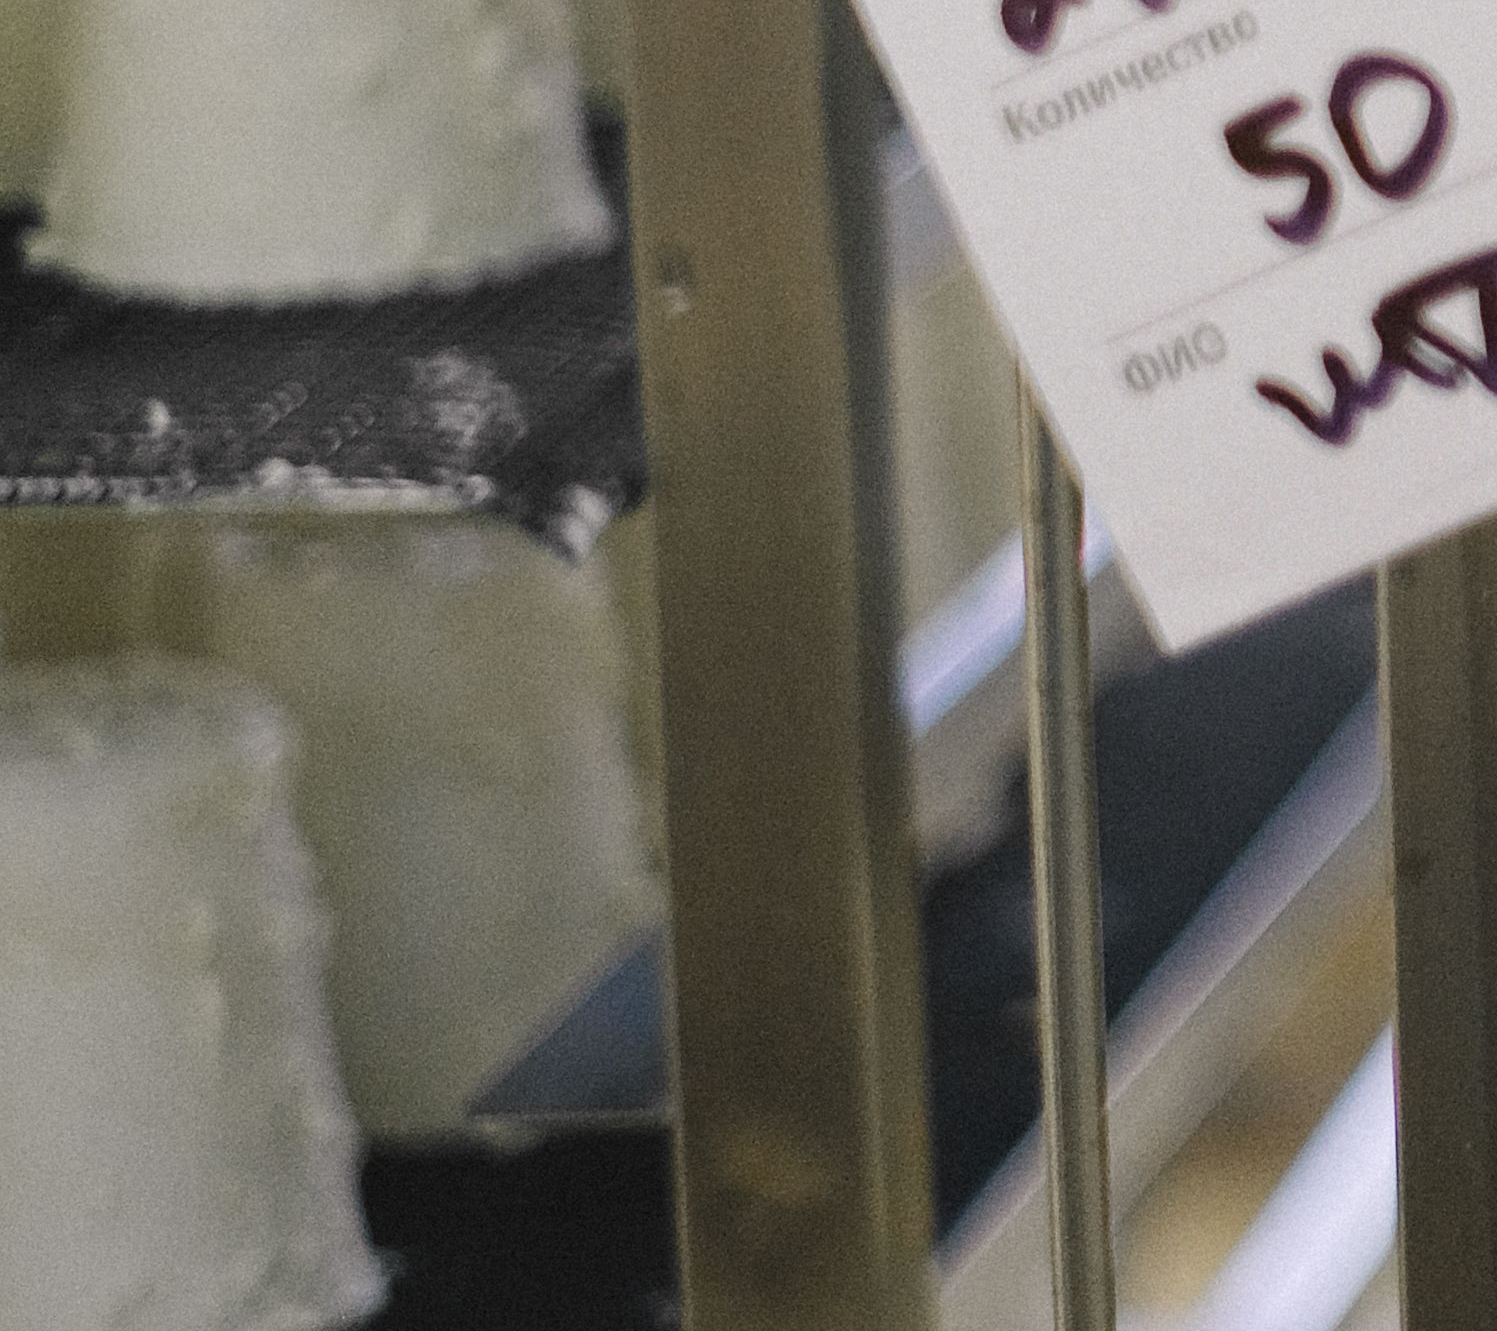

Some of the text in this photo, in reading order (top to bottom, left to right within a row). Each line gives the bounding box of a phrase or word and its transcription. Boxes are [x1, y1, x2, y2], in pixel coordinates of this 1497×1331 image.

[1000, 9, 1262, 146] Количество
[1224, 52, 1453, 244] 50
[1121, 321, 1229, 394] ФИО
